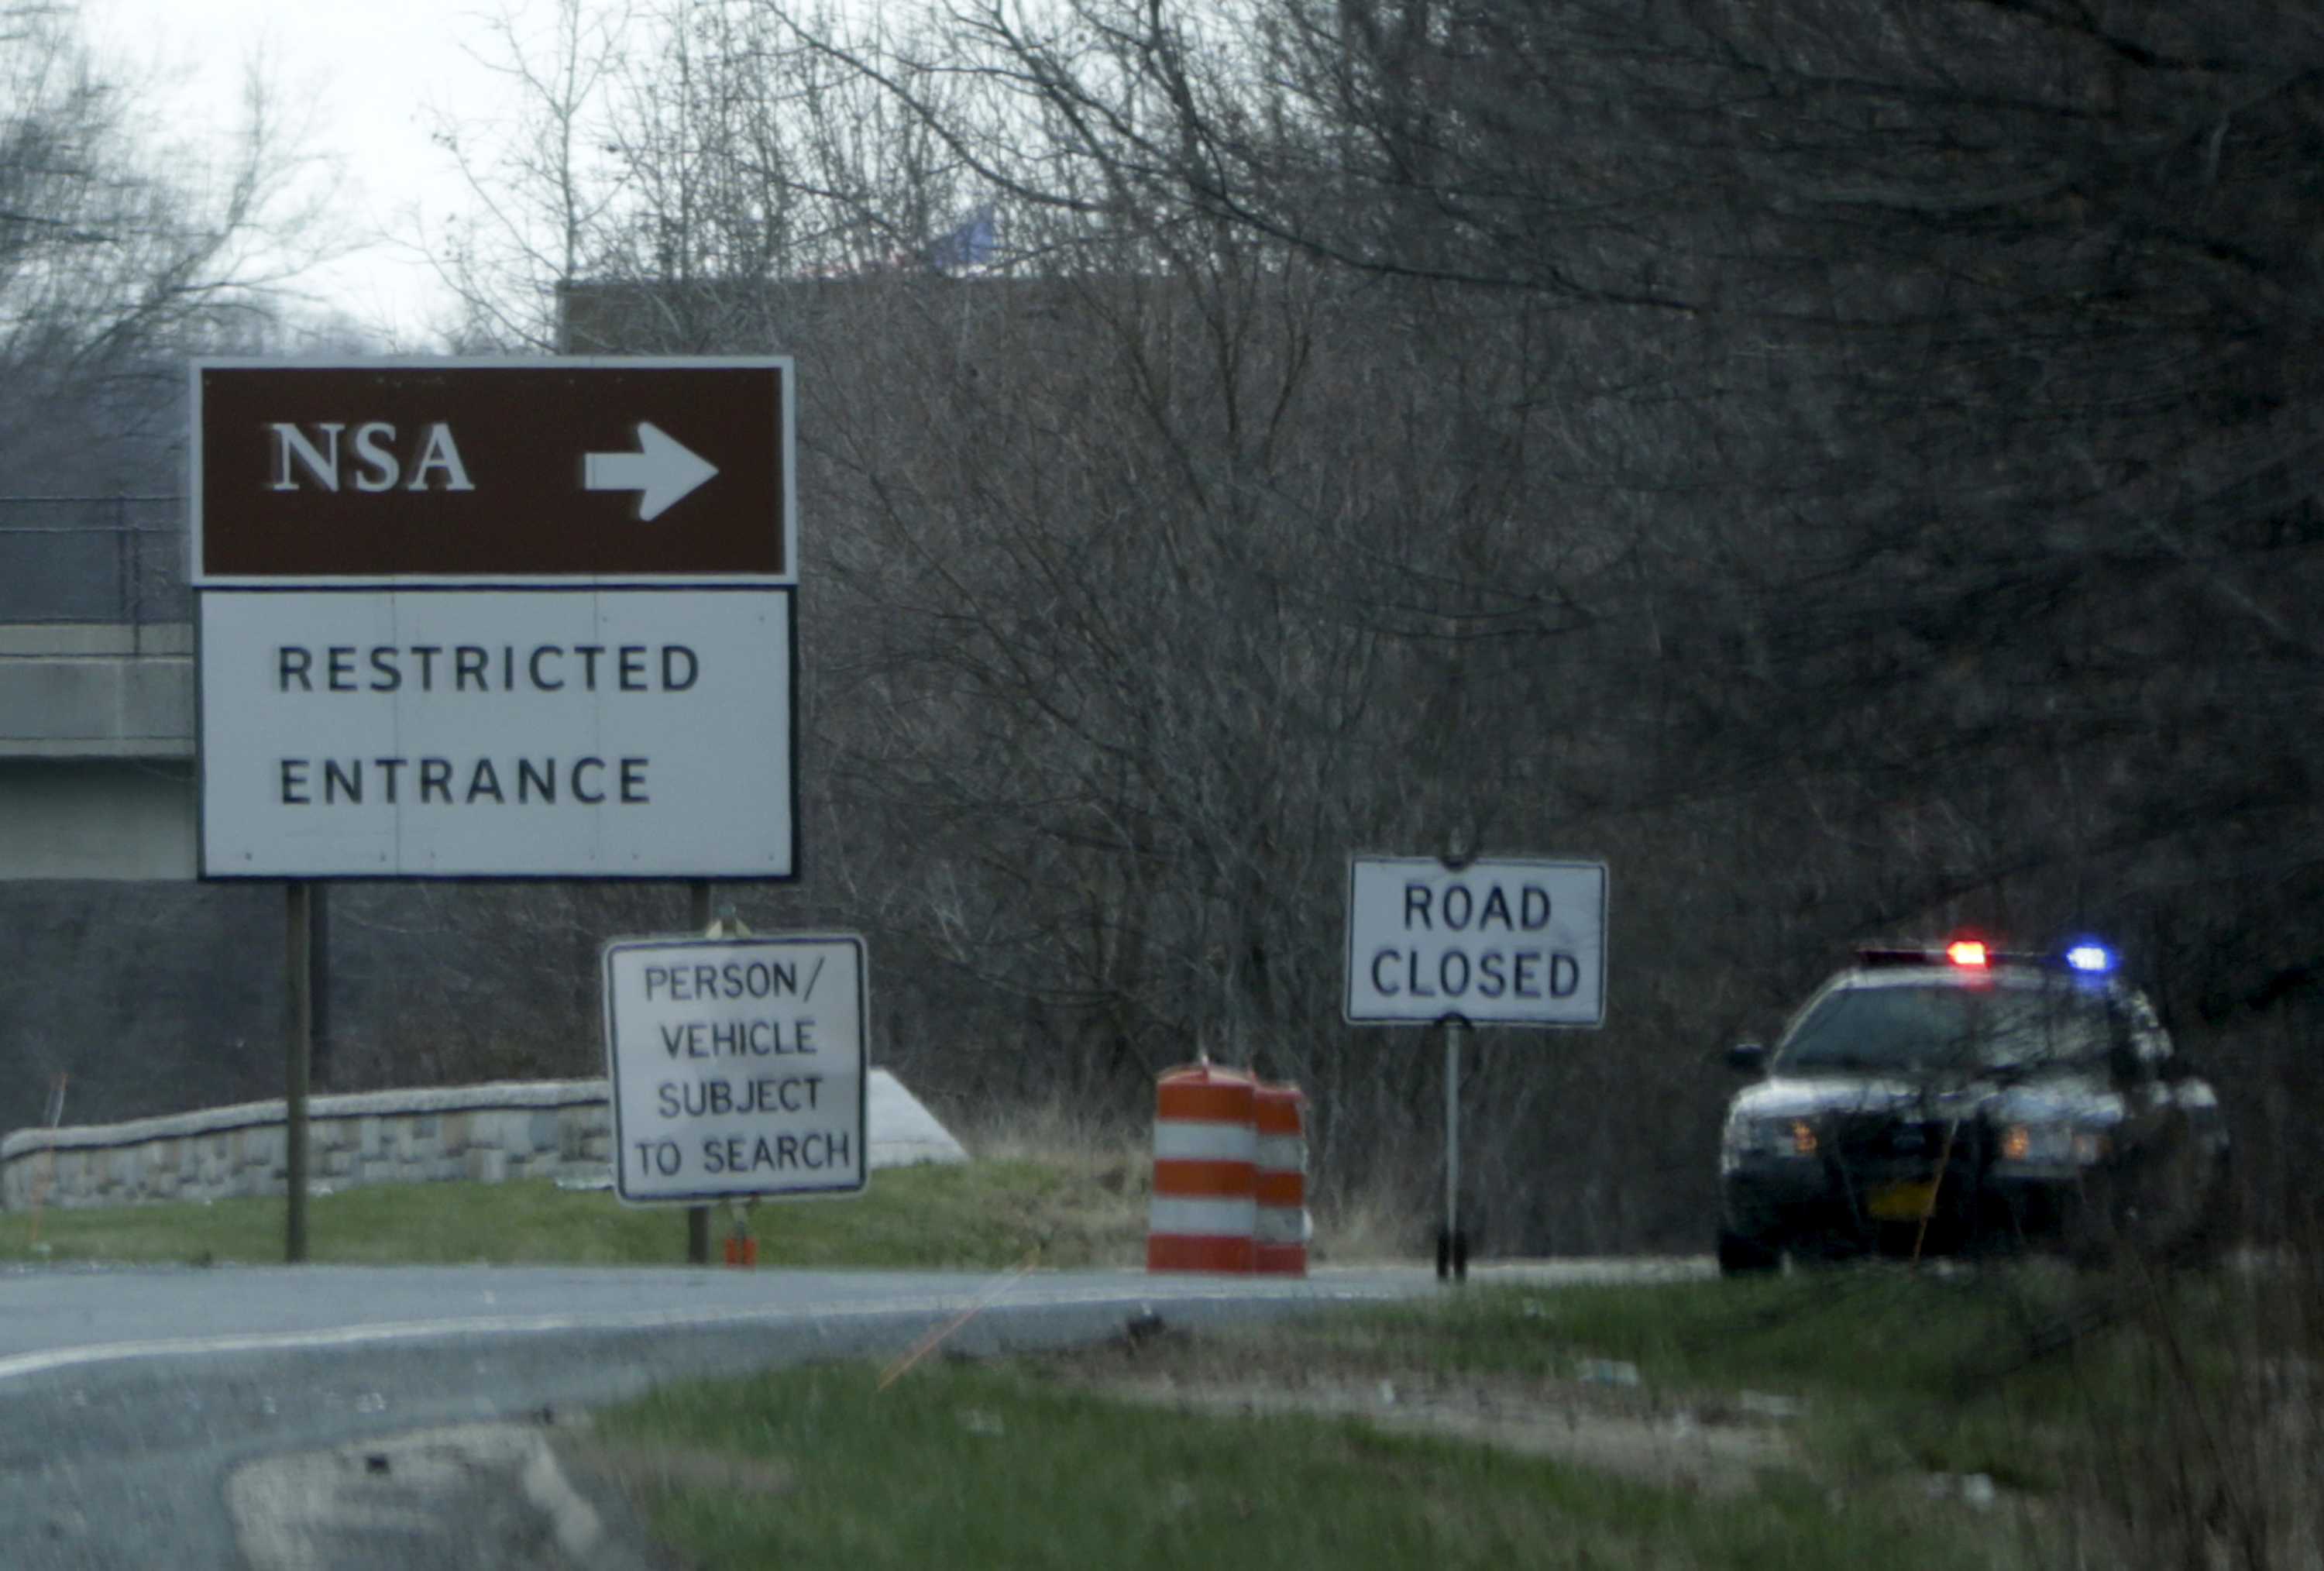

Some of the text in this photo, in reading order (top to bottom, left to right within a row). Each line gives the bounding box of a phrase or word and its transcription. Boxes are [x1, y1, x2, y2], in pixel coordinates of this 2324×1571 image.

[271, 422, 476, 492] NSA
[278, 645, 699, 692] RESTRICTED
[280, 758, 651, 804] ENTRANCE
[1404, 883, 1551, 930] ROAD
[645, 957, 824, 1002] PERSON/
[1372, 949, 1579, 999] CLOSED
[662, 1019, 817, 1059] VEHICLE
[658, 1077, 823, 1118] SUBJECT
[635, 1132, 850, 1176] TO SEARCH
